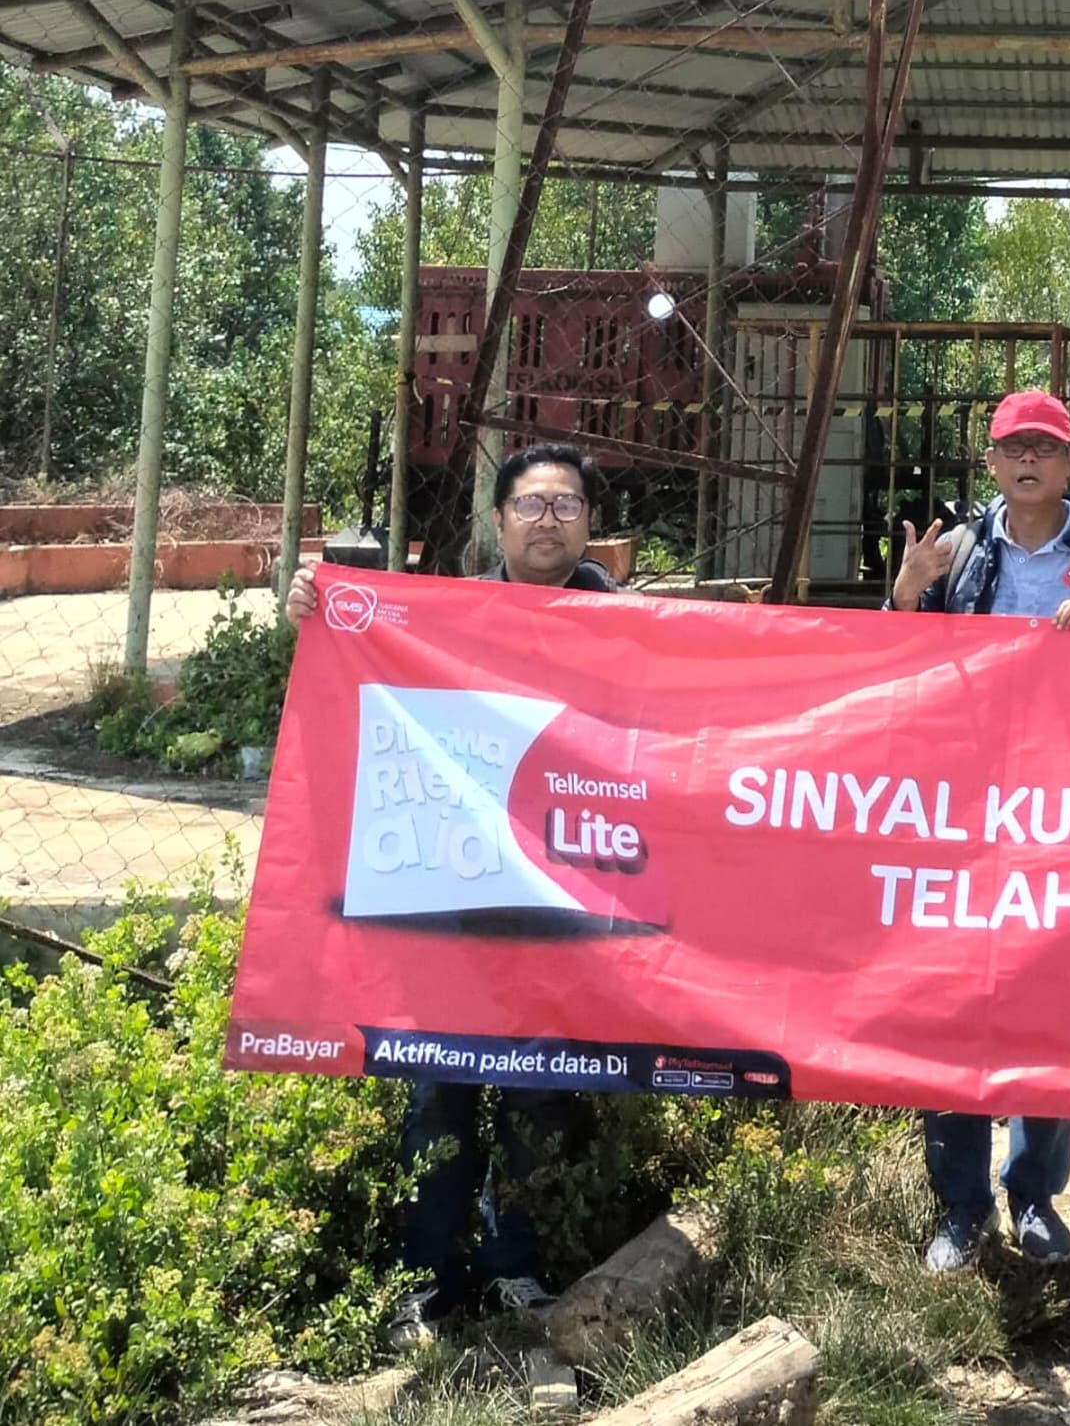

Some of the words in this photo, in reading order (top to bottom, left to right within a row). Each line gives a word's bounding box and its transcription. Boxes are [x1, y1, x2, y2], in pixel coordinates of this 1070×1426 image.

[544, 772, 648, 801] Telkomsel
[725, 766, 969, 841] SINYAL
[552, 807, 641, 859] Lite
[239, 1032, 345, 1062] PraBayar
[373, 1040, 476, 1069] Aktifkan
[479, 1049, 545, 1073] paket
[549, 1050, 601, 1075] data
[606, 1055, 628, 1076] Di
